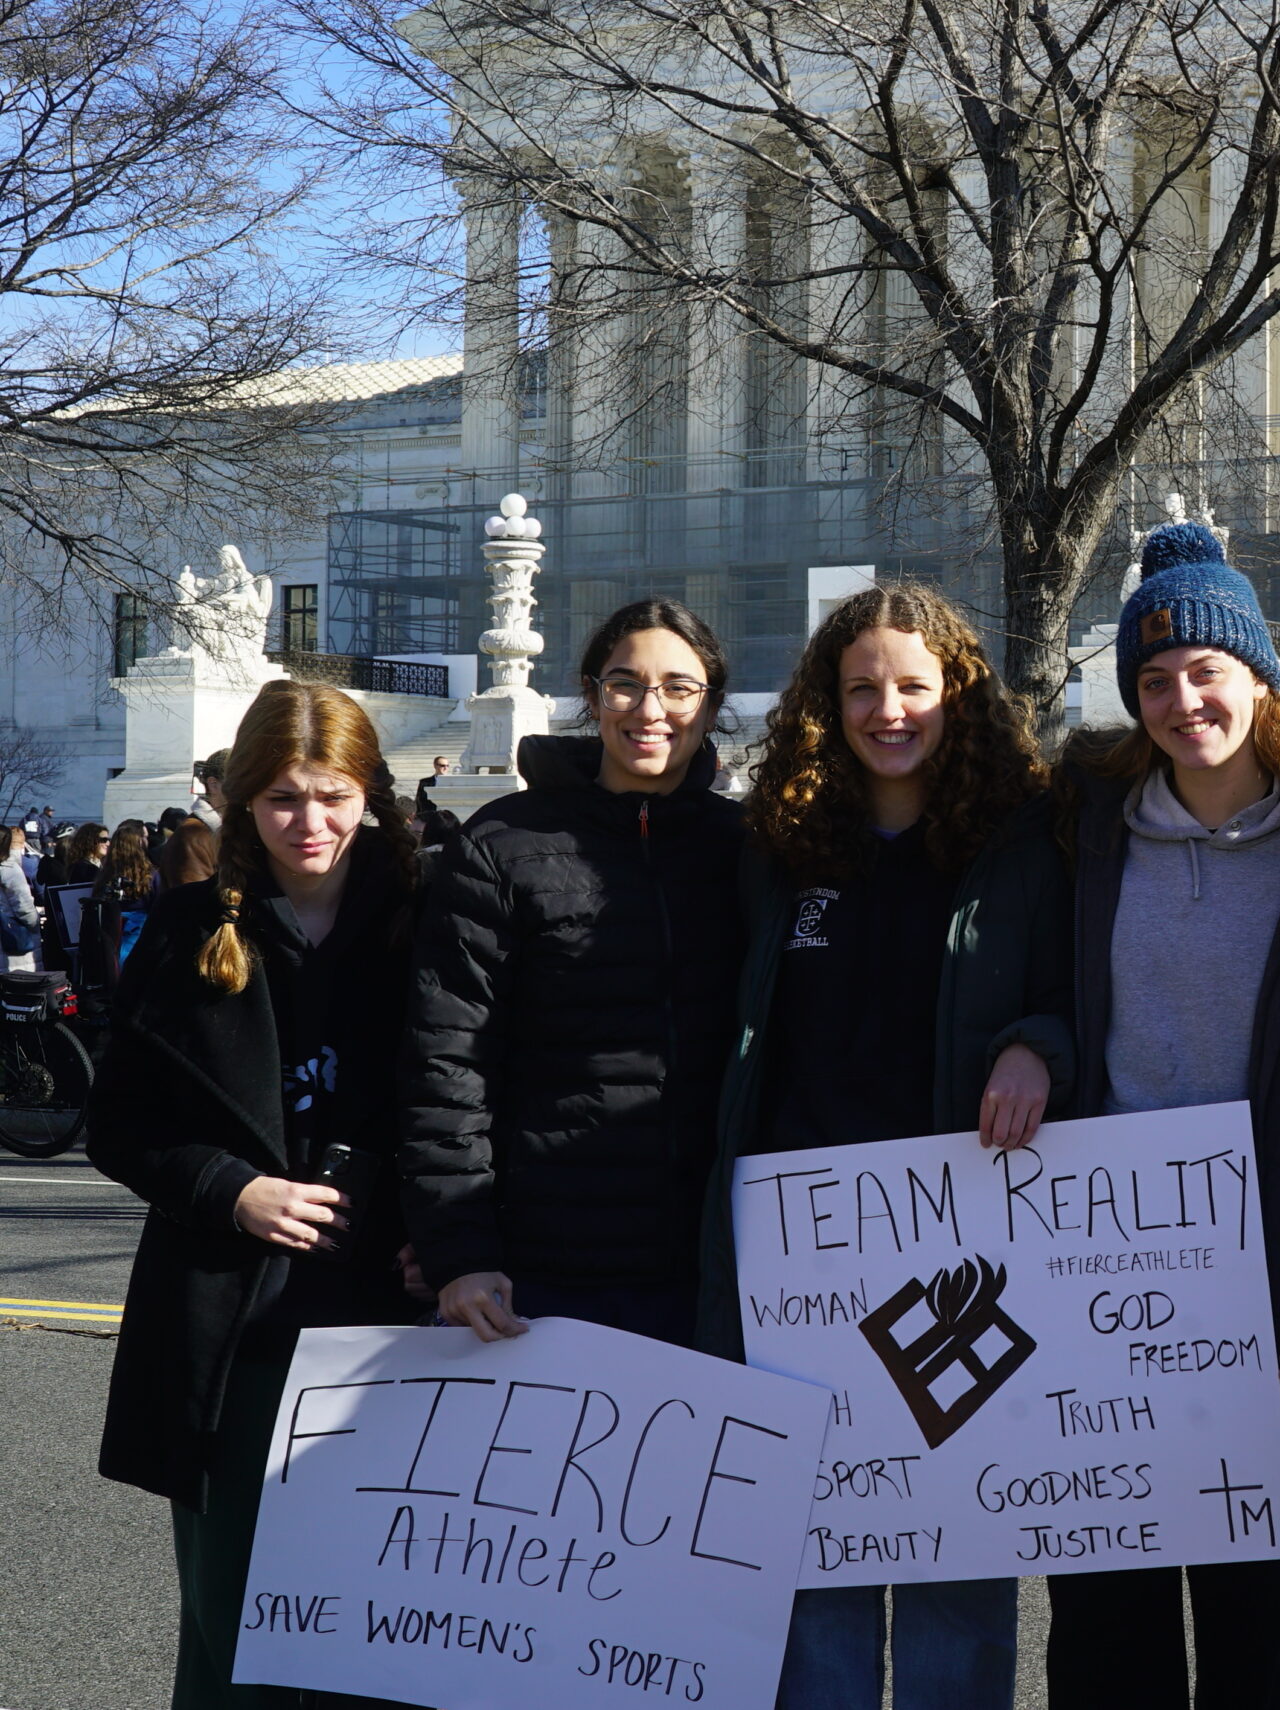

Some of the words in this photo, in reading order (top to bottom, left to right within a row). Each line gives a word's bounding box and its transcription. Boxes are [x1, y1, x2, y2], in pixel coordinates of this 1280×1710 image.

[6, 1013, 26, 1022] POLICE
[743, 1162, 961, 1256] TEAM
[993, 1146, 1248, 1252] REALITY
[1046, 1248, 1215, 1279] #FIERCEATHLETE
[750, 1278, 868, 1328] WOMAN
[1089, 1291, 1175, 1335] GOD
[1129, 1334, 1262, 1377] FREEDOM
[835, 1390, 853, 1427] H
[1046, 1388, 1156, 1437] TRUTH
[281, 1377, 789, 1571] FIERCE
[813, 1456, 921, 1501] SPORT
[976, 1464, 1152, 1513] GOODNESS
[377, 1505, 623, 1601] Athlete
[808, 1526, 943, 1571] BEAUTY
[1016, 1522, 1162, 1561] JUSTICE
[245, 1592, 342, 1634] SAVE
[367, 1600, 537, 1662] WOMEN'S
[578, 1638, 706, 1702] SPORTS
